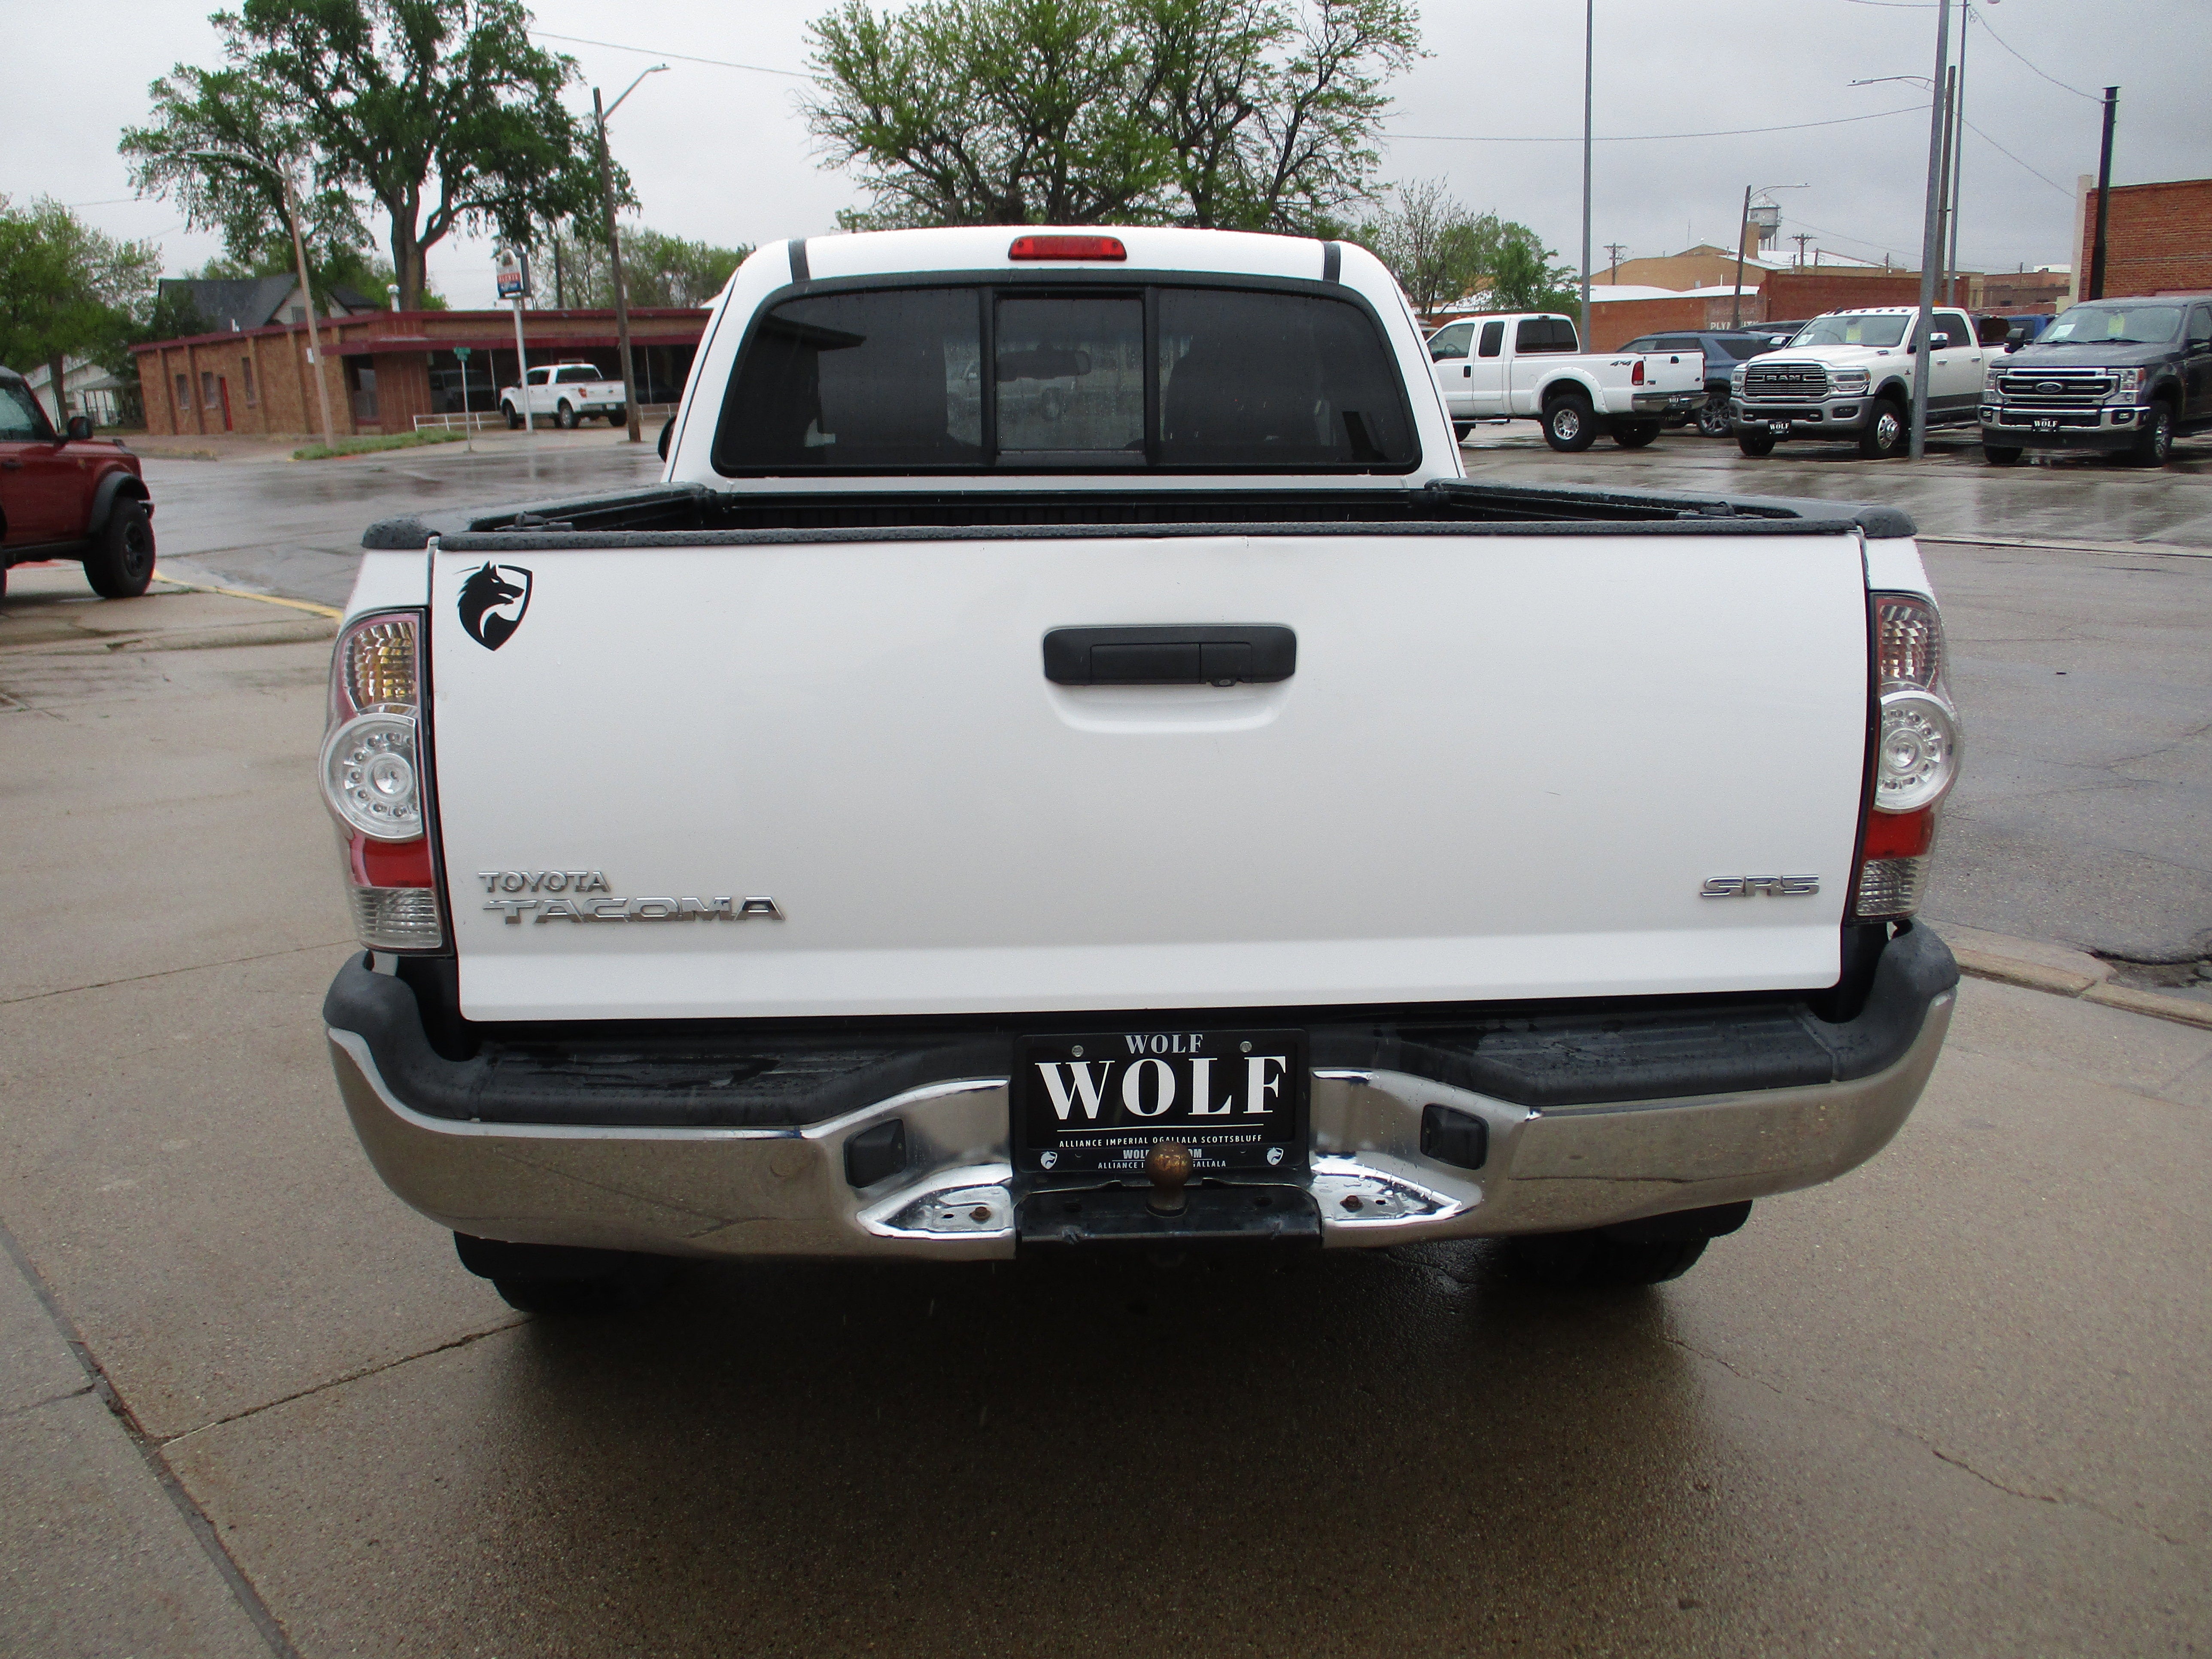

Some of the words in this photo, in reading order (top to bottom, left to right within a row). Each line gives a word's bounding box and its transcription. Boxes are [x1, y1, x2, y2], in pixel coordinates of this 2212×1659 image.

[478, 871, 611, 893] TOYOTA
[1700, 874, 1820, 897] SR5
[483, 896, 785, 924] TACOMA
[1124, 1034, 1203, 1054] WOLF
[1034, 1056, 1286, 1120] WOLF
[1059, 1139, 1102, 1148] ALLIANCE
[1106, 1137, 1148, 1146] IMPERIAL
[1201, 1134, 1262, 1143] SCOTTSBLUFF
